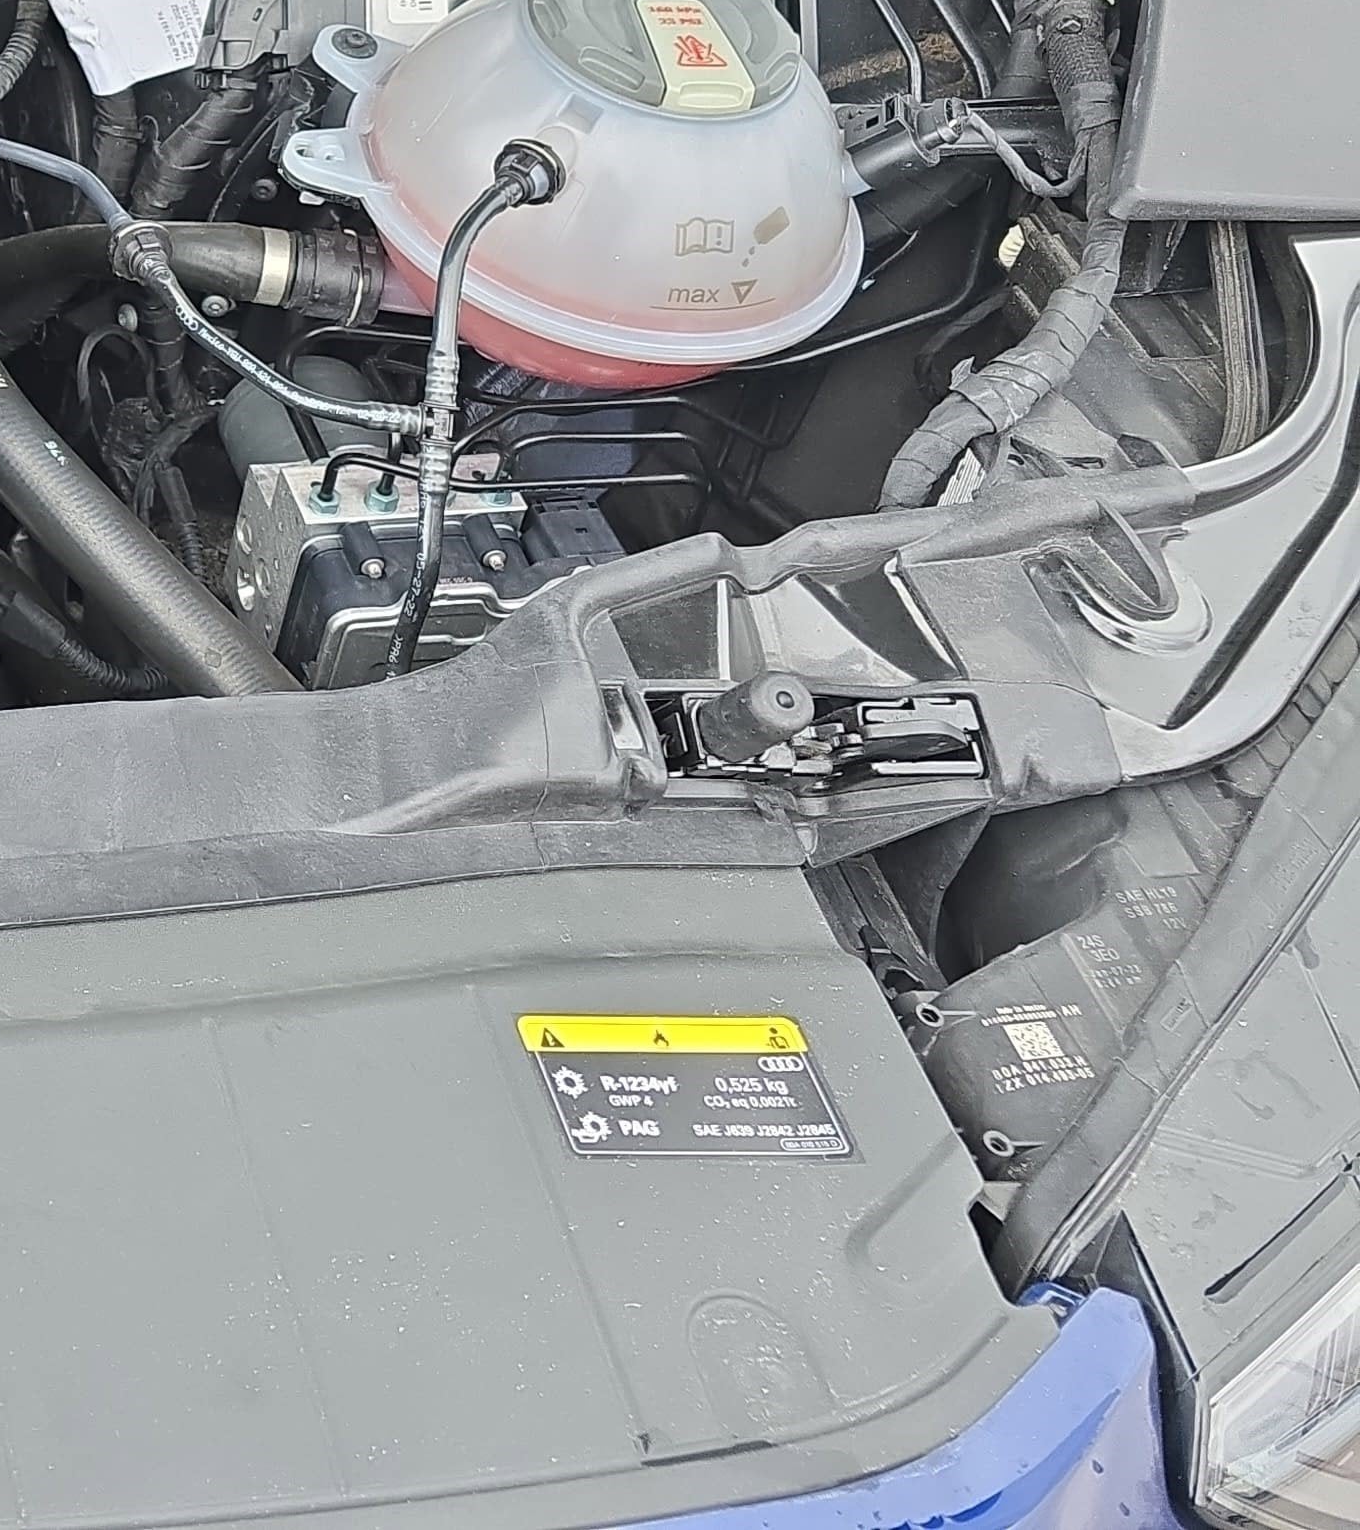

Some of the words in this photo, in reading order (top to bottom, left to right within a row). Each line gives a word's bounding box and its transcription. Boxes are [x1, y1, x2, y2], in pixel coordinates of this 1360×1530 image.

[667, 286, 719, 304] max
[601, 1075, 679, 1095] R-1234yf
[714, 1077, 763, 1094] 0,525
[763, 1077, 789, 1096] kg
[608, 1094, 641, 1108] GWP
[643, 1095, 654, 1109] 4
[618, 1119, 660, 1137] PAG
[692, 1123, 722, 1137] SAE
[724, 1123, 755, 1137] J639
[756, 1123, 796, 1137] J2842
[796, 1123, 837, 1136] J2845
